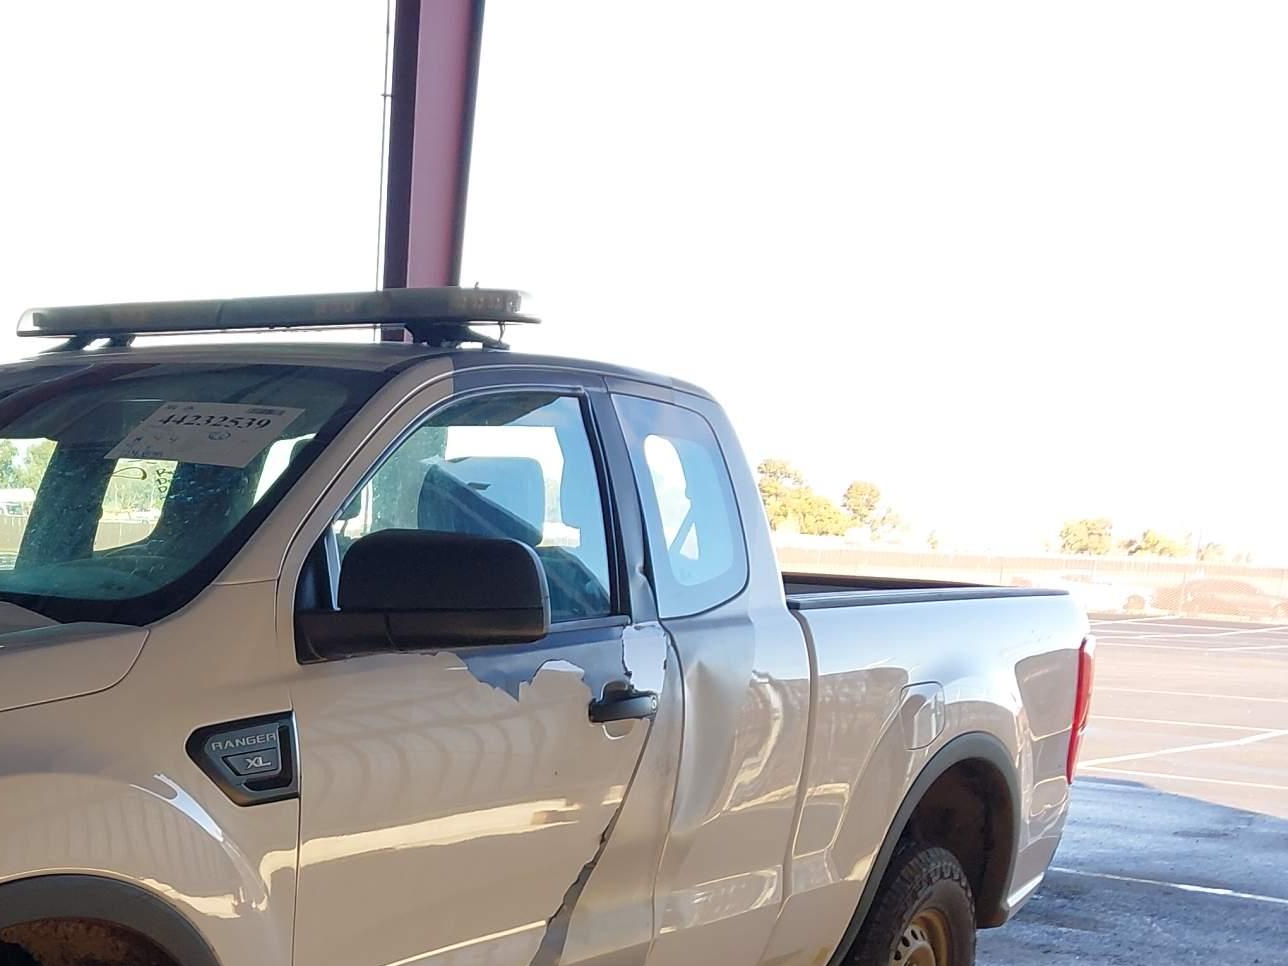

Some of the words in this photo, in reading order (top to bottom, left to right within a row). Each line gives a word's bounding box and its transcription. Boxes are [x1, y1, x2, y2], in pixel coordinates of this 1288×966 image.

[159, 414, 271, 430] 44232539
[212, 733, 276, 751] RANGER
[245, 756, 272, 769] XL
